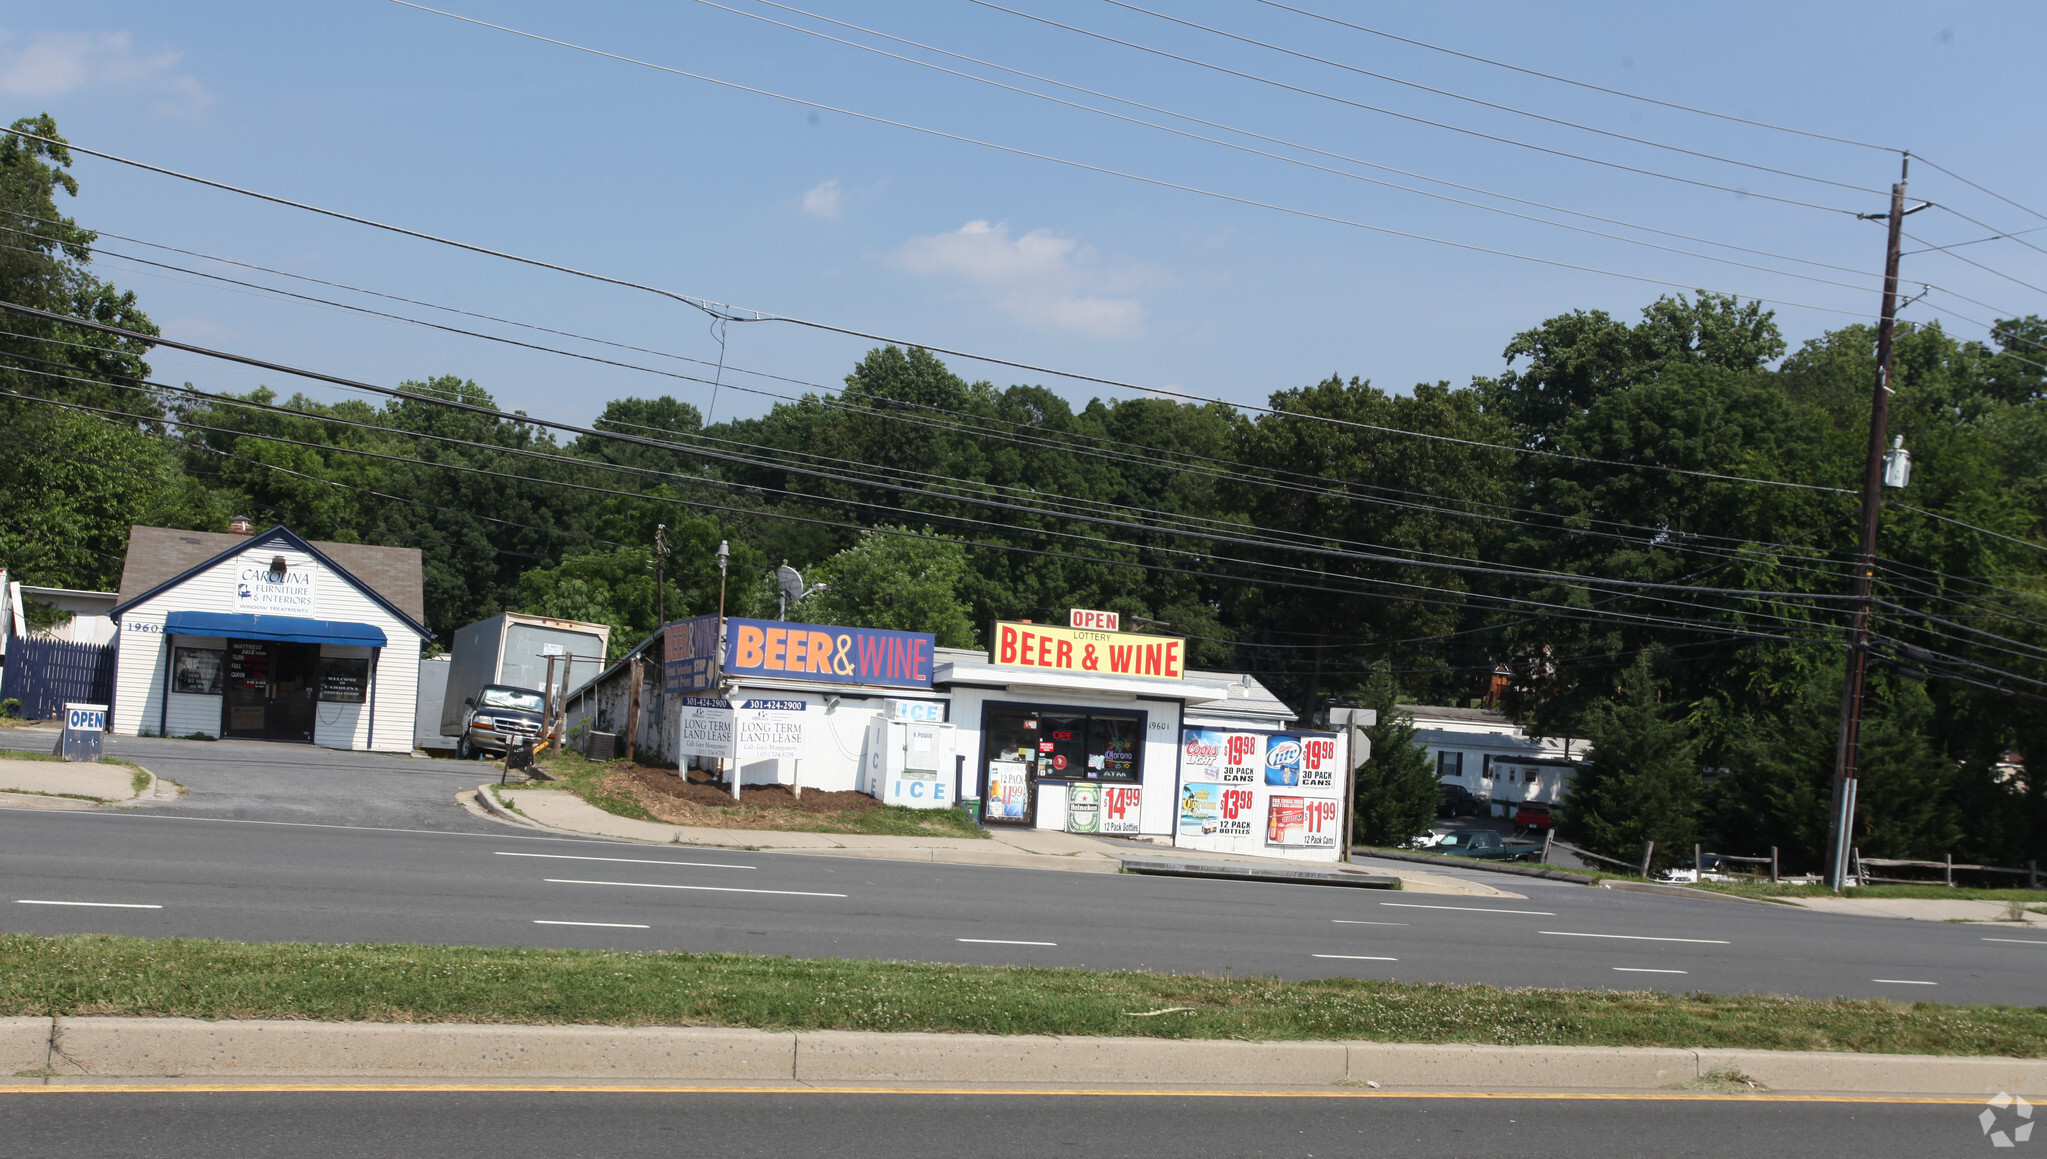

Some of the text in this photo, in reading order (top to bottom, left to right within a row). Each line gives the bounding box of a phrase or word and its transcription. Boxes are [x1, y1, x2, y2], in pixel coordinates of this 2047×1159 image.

[242, 569, 309, 584] CAROLINA
[256, 584, 308, 596] FURNITURE
[254, 594, 312, 606] & INTERIORS
[1073, 611, 1117, 630] OPEN
[1074, 631, 1112, 642] LOTTERY
[1000, 626, 1179, 678] BEER & WINE
[686, 698, 727, 708] 301-424-2900
[750, 700, 802, 710] 301-424-2900
[901, 704, 938, 720] ICE
[71, 710, 104, 728] OPEN
[684, 719, 731, 732] LONG TERM
[742, 722, 802, 734] LONG TERM
[1148, 722, 1170, 730] 19601
[684, 729, 732, 742] LAND LEASE
[740, 732, 802, 744] LAND LEASE
[705, 742, 728, 750] Montgomery
[769, 744, 797, 752] Montgomery
[1186, 739, 1219, 756] Coors
[1105, 750, 1132, 760] Corona
[1186, 755, 1217, 766] LIGHT
[1273, 750, 1298, 766] Lite
[1008, 774, 1024, 784] PACK
[1224, 774, 1254, 782] CANS
[1302, 770, 1332, 780] 30 PACK
[894, 780, 946, 800] ICE
[1070, 803, 1098, 812] Heineken
[1183, 798, 1216, 811] Corona
[1104, 822, 1138, 832] 12 Pack Bottles
[1220, 820, 1229, 828] 12
[1304, 836, 1334, 844] 12 Pack Cans
